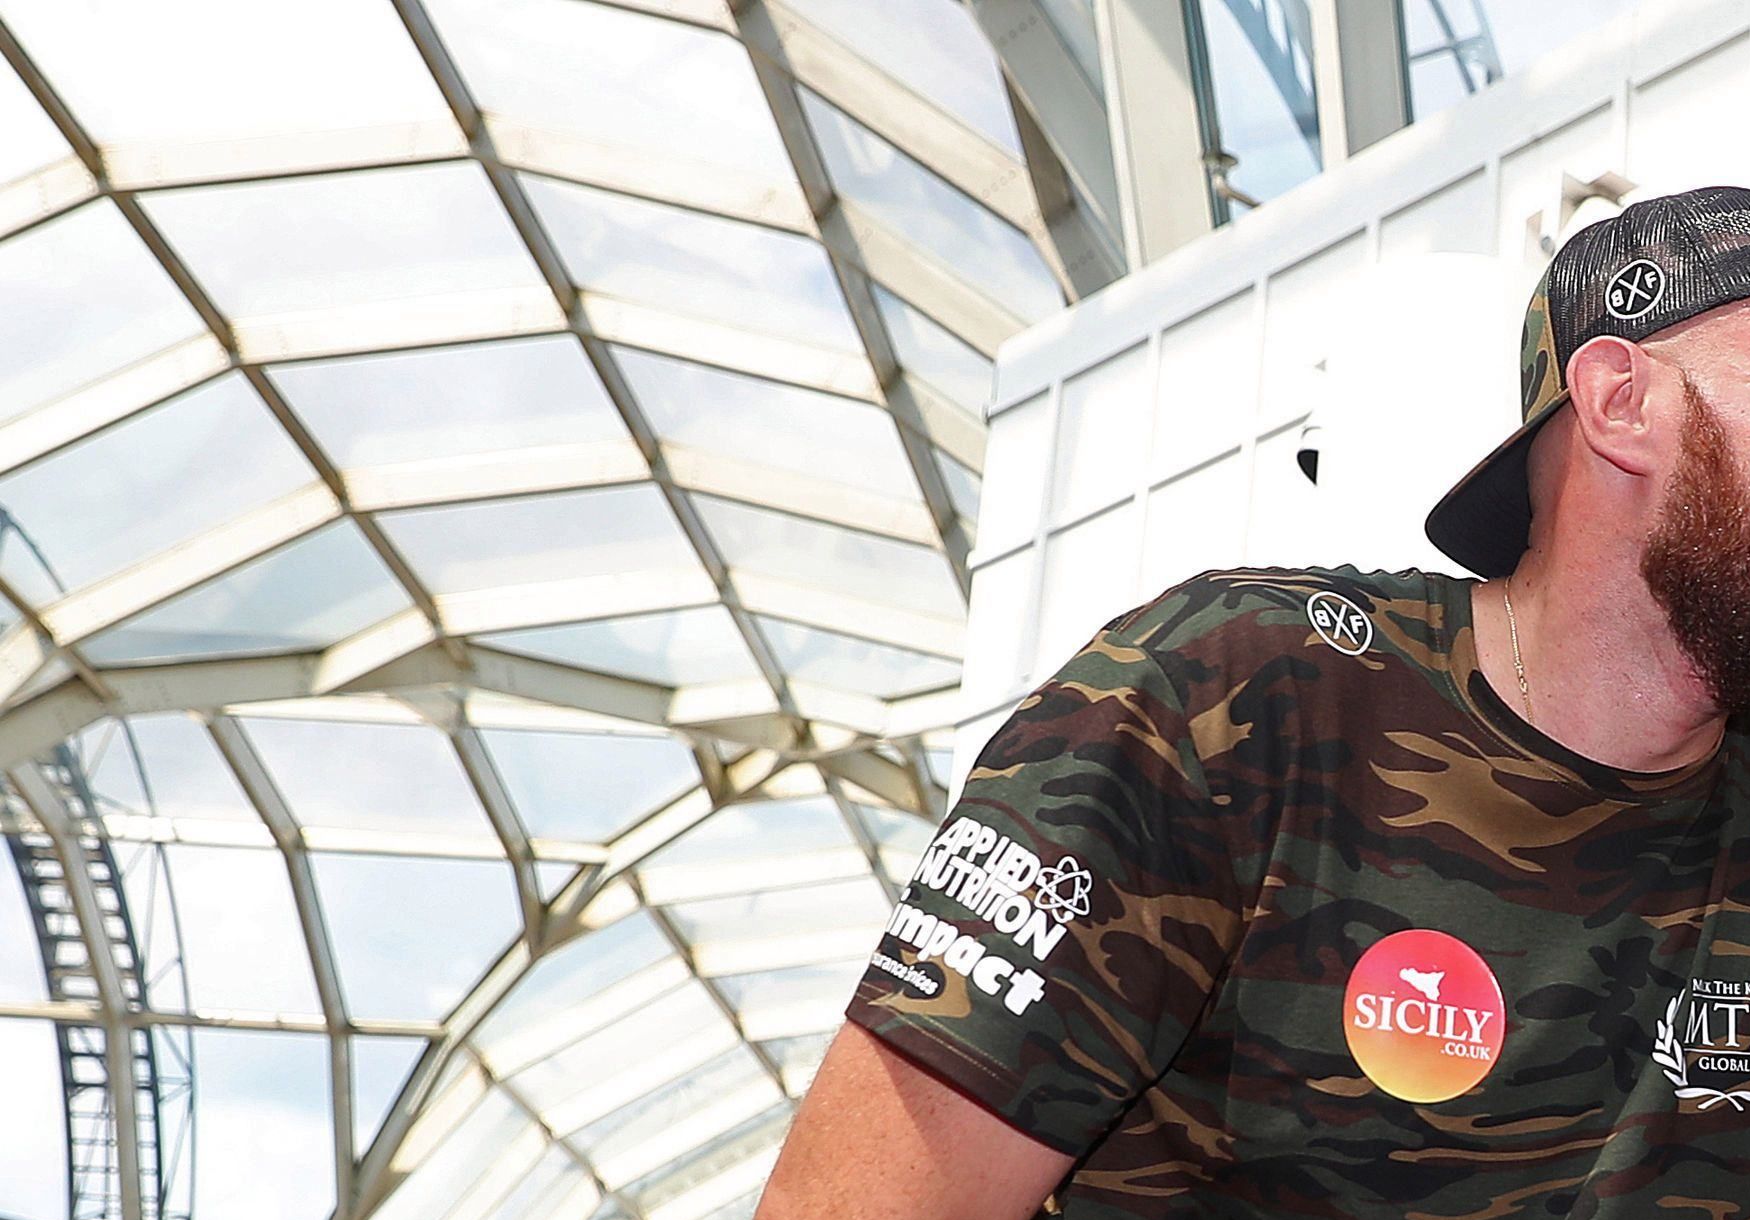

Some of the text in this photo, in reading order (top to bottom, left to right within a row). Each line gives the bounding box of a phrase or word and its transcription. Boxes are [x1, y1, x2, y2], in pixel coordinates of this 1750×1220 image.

[933, 816, 1042, 893] APPLIED
[913, 845, 1068, 962] NUTRITION
[887, 887, 1046, 1016] impact
[1353, 993, 1494, 1044] SICILY
[1713, 980, 1741, 995] THE
[1698, 1056, 1750, 1072] GLOBAL
